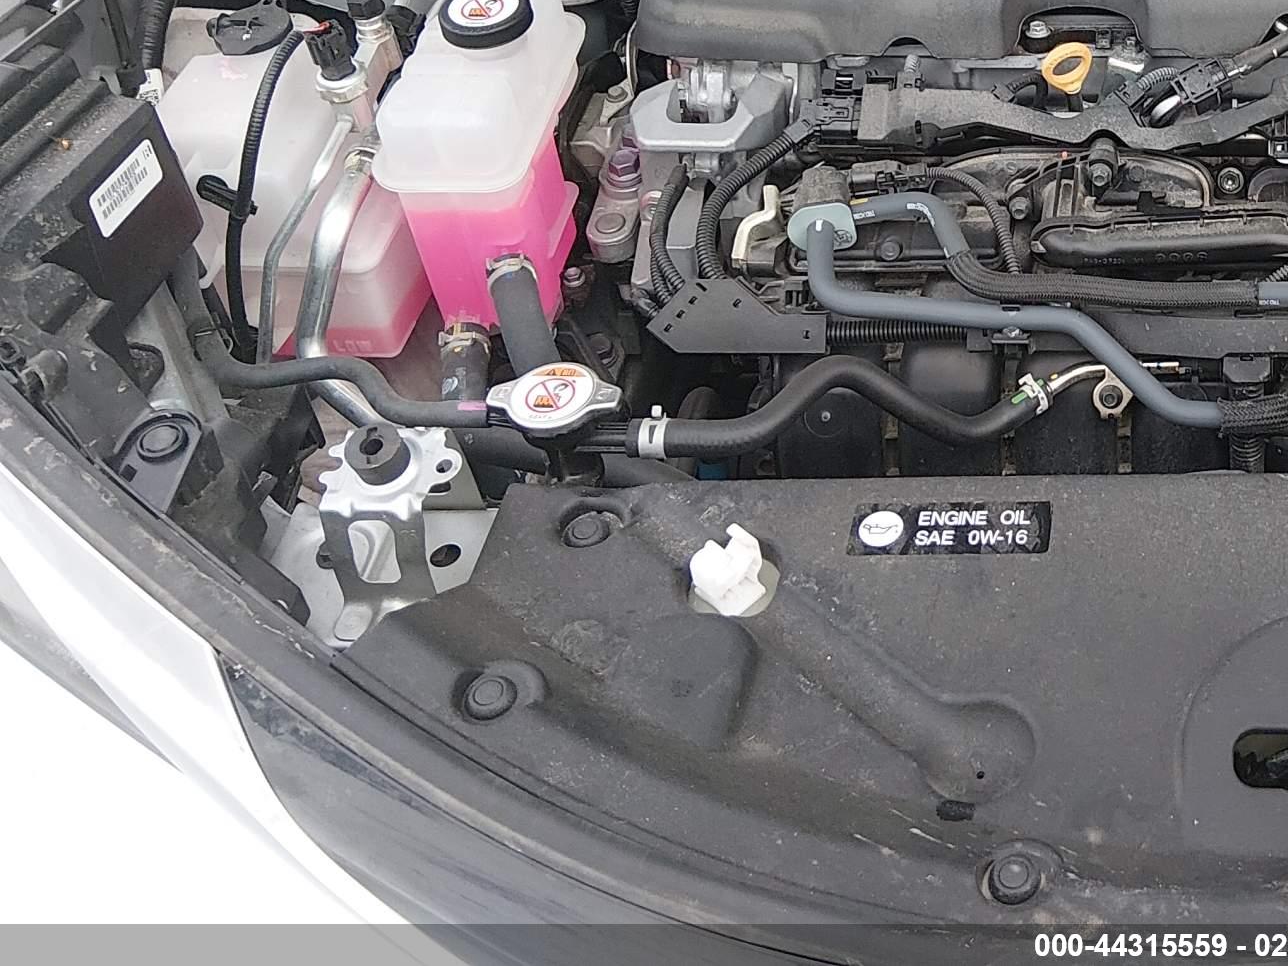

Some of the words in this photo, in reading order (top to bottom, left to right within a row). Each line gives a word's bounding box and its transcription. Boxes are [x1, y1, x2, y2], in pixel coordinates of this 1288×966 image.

[917, 510, 988, 526] ENGINE
[1000, 510, 1031, 526] OIL
[914, 530, 955, 546] SAE
[967, 529, 1028, 546] 0W-16
